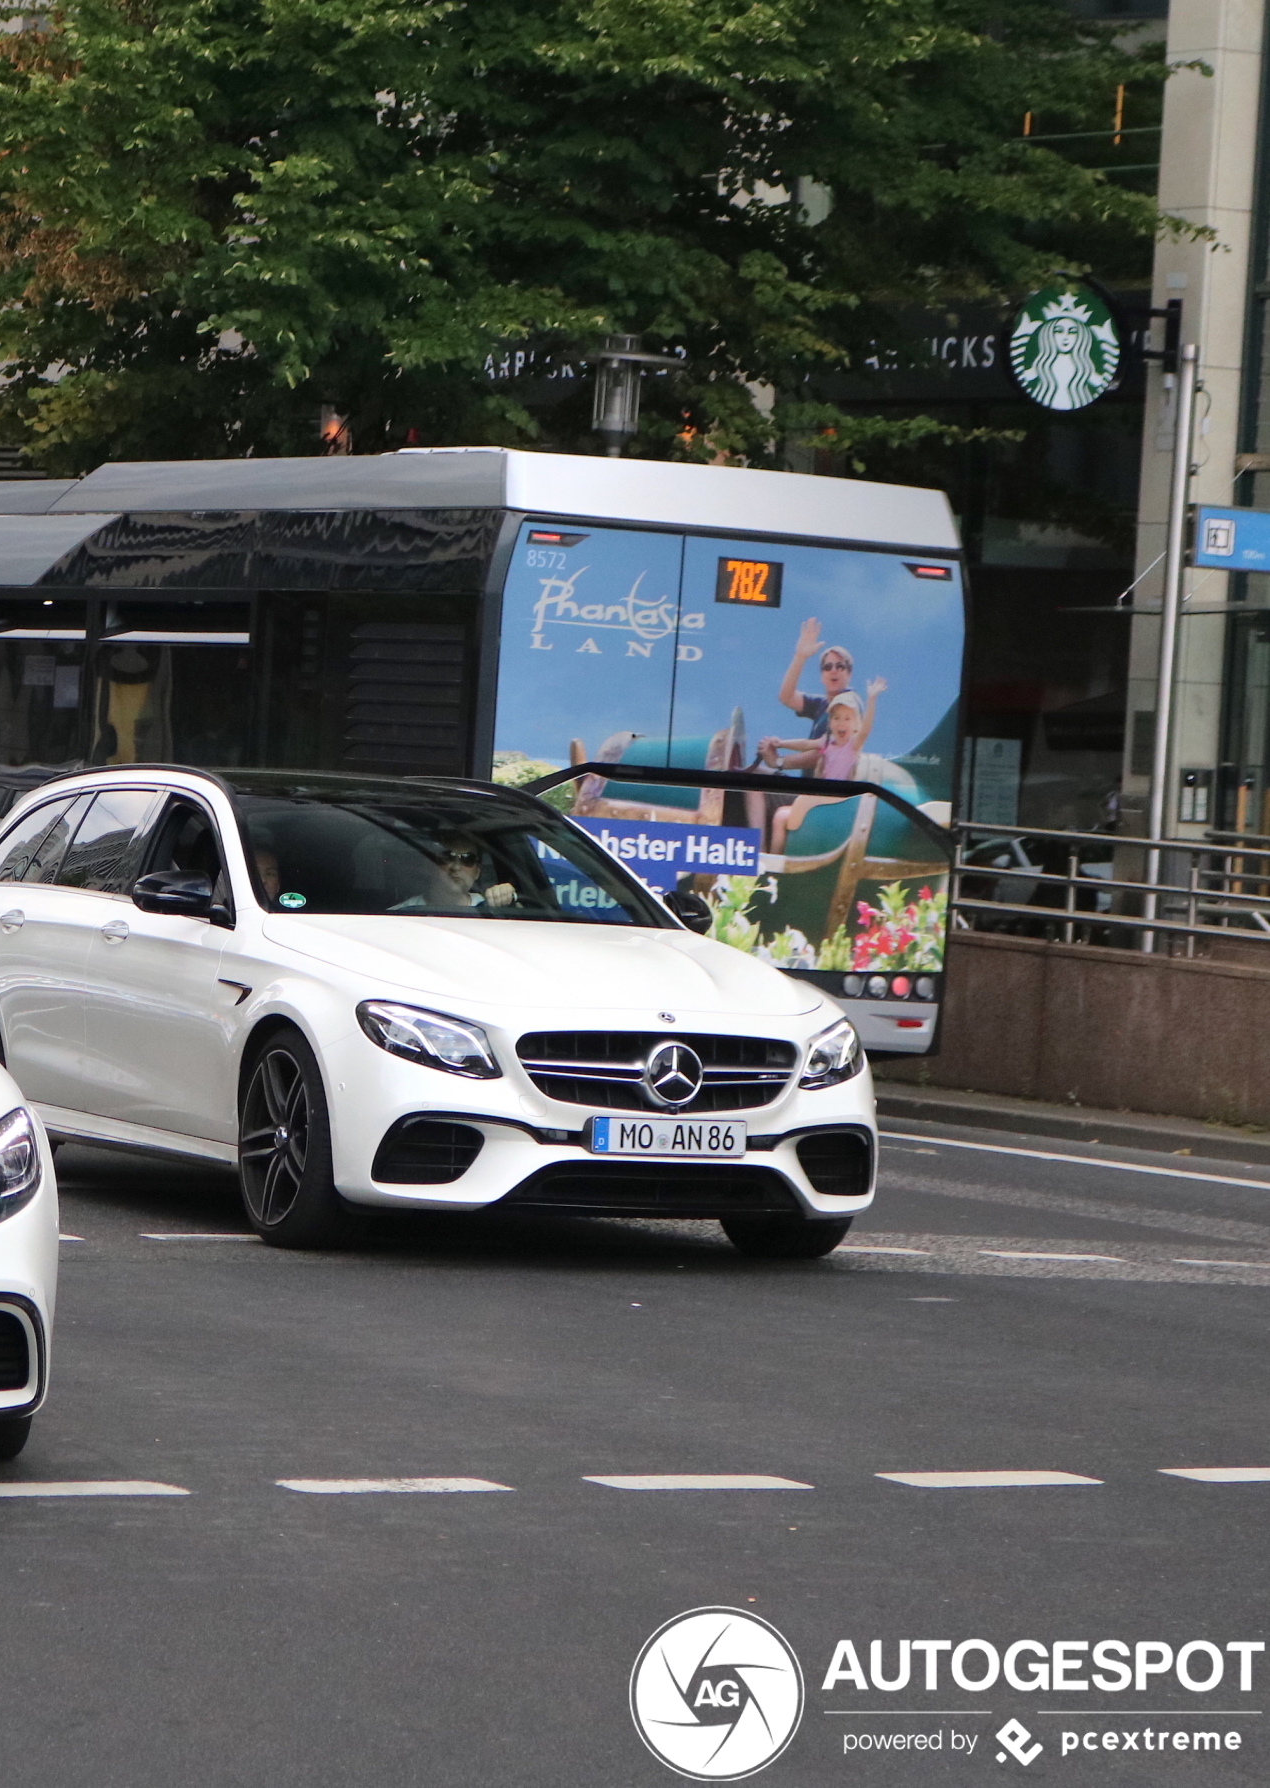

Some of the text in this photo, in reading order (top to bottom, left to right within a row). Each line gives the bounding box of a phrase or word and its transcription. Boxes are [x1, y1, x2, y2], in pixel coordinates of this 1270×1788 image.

[526, 549, 567, 571] 8572
[726, 560, 769, 602] 782
[532, 566, 706, 640] Phantasia
[530, 633, 703, 661] LAND
[687, 836, 755, 867] Halt:
[619, 1123, 735, 1151] MO AN 86
